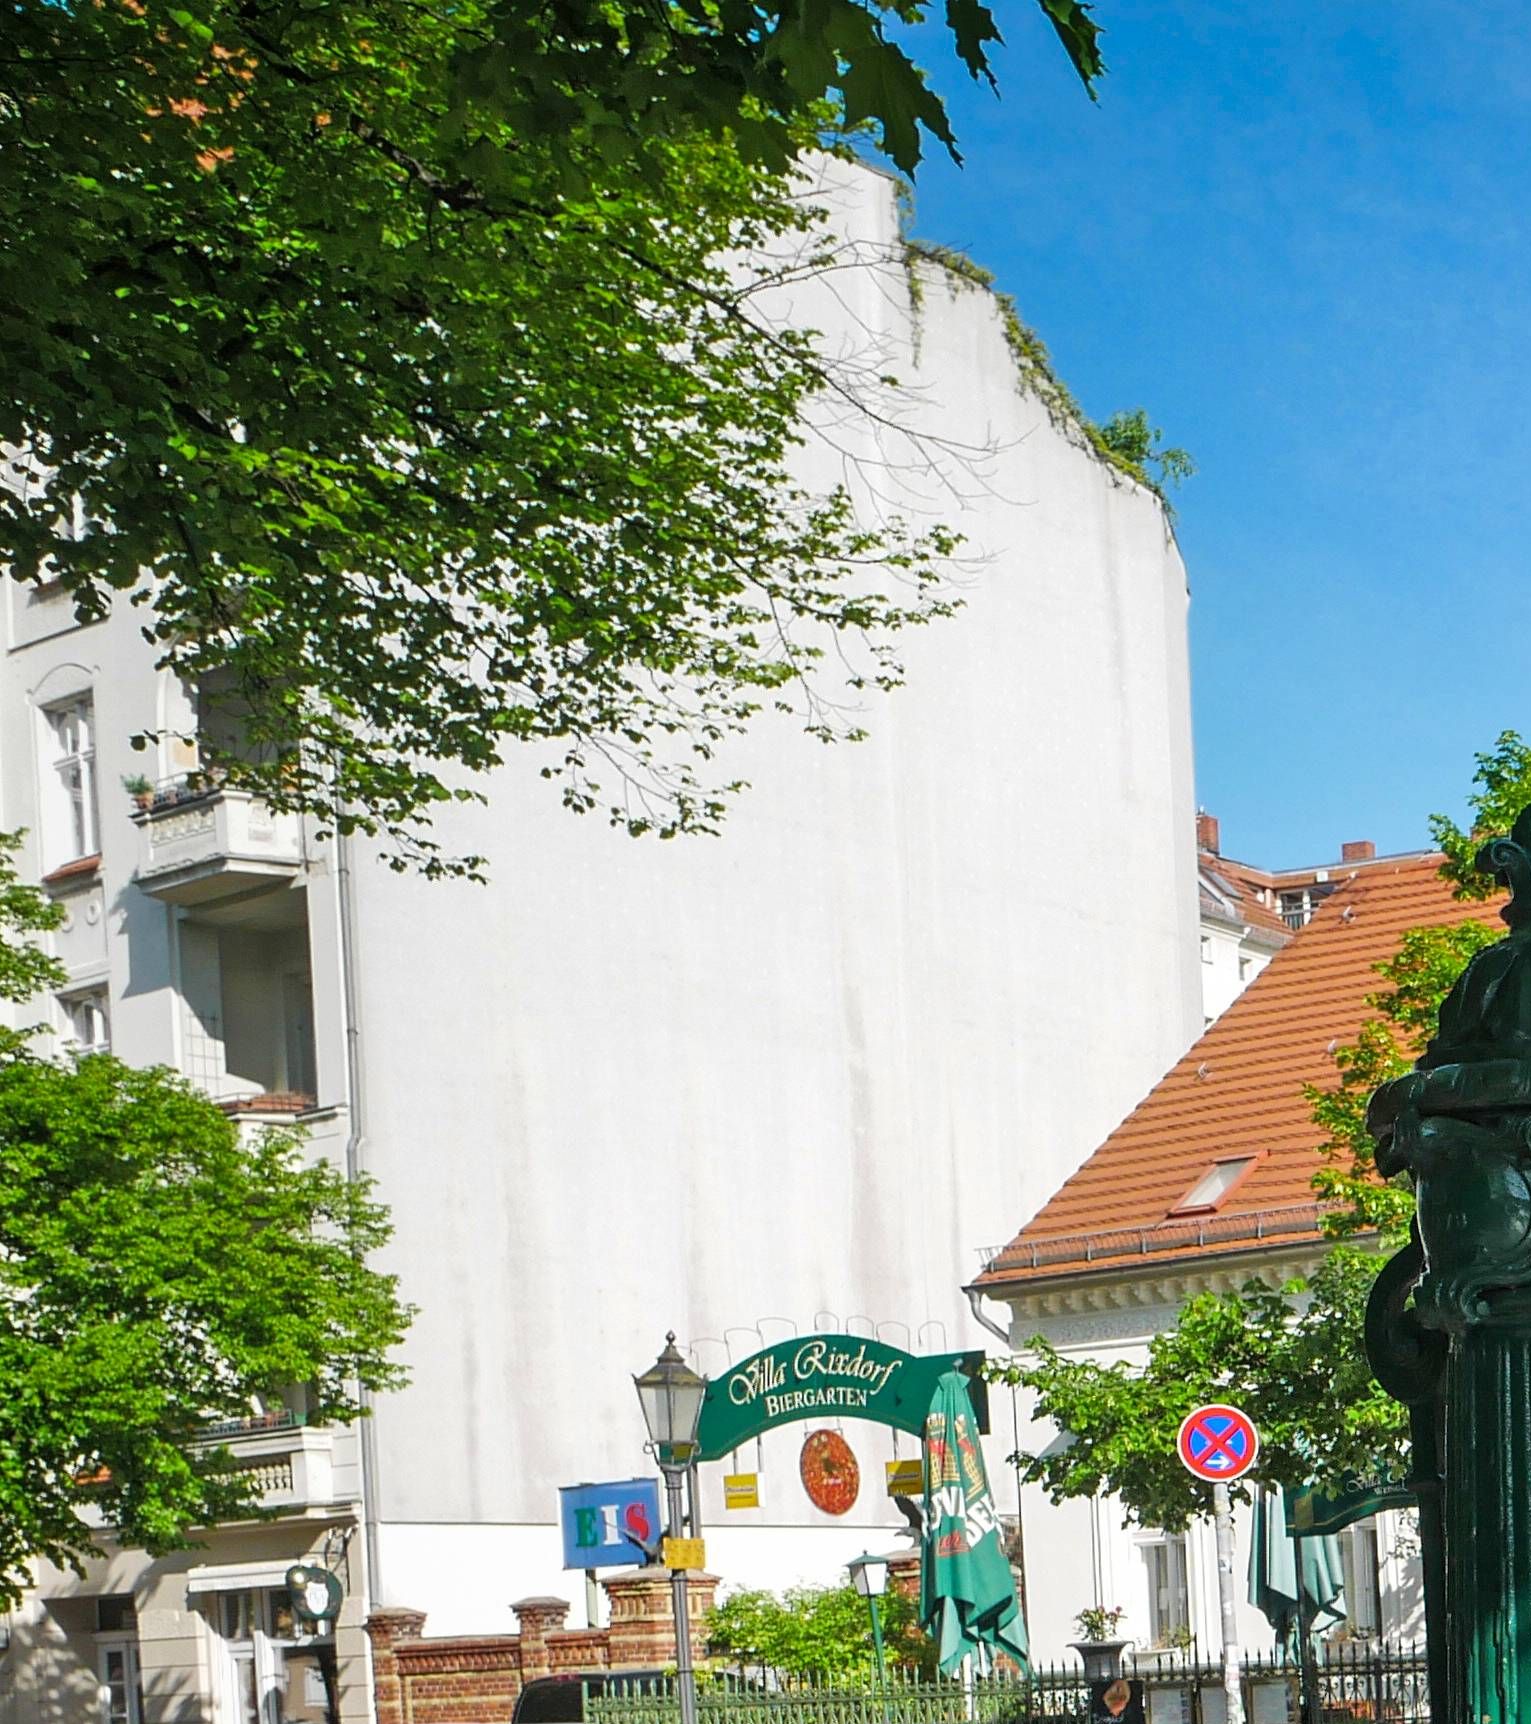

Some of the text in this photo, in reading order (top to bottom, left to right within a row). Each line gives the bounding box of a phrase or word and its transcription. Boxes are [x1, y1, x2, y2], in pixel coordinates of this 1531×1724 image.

[729, 1340, 903, 1405] Villa Rixdorf
[765, 1387, 867, 1417] BIERGARTEN
[574, 1503, 650, 1548] EIS
